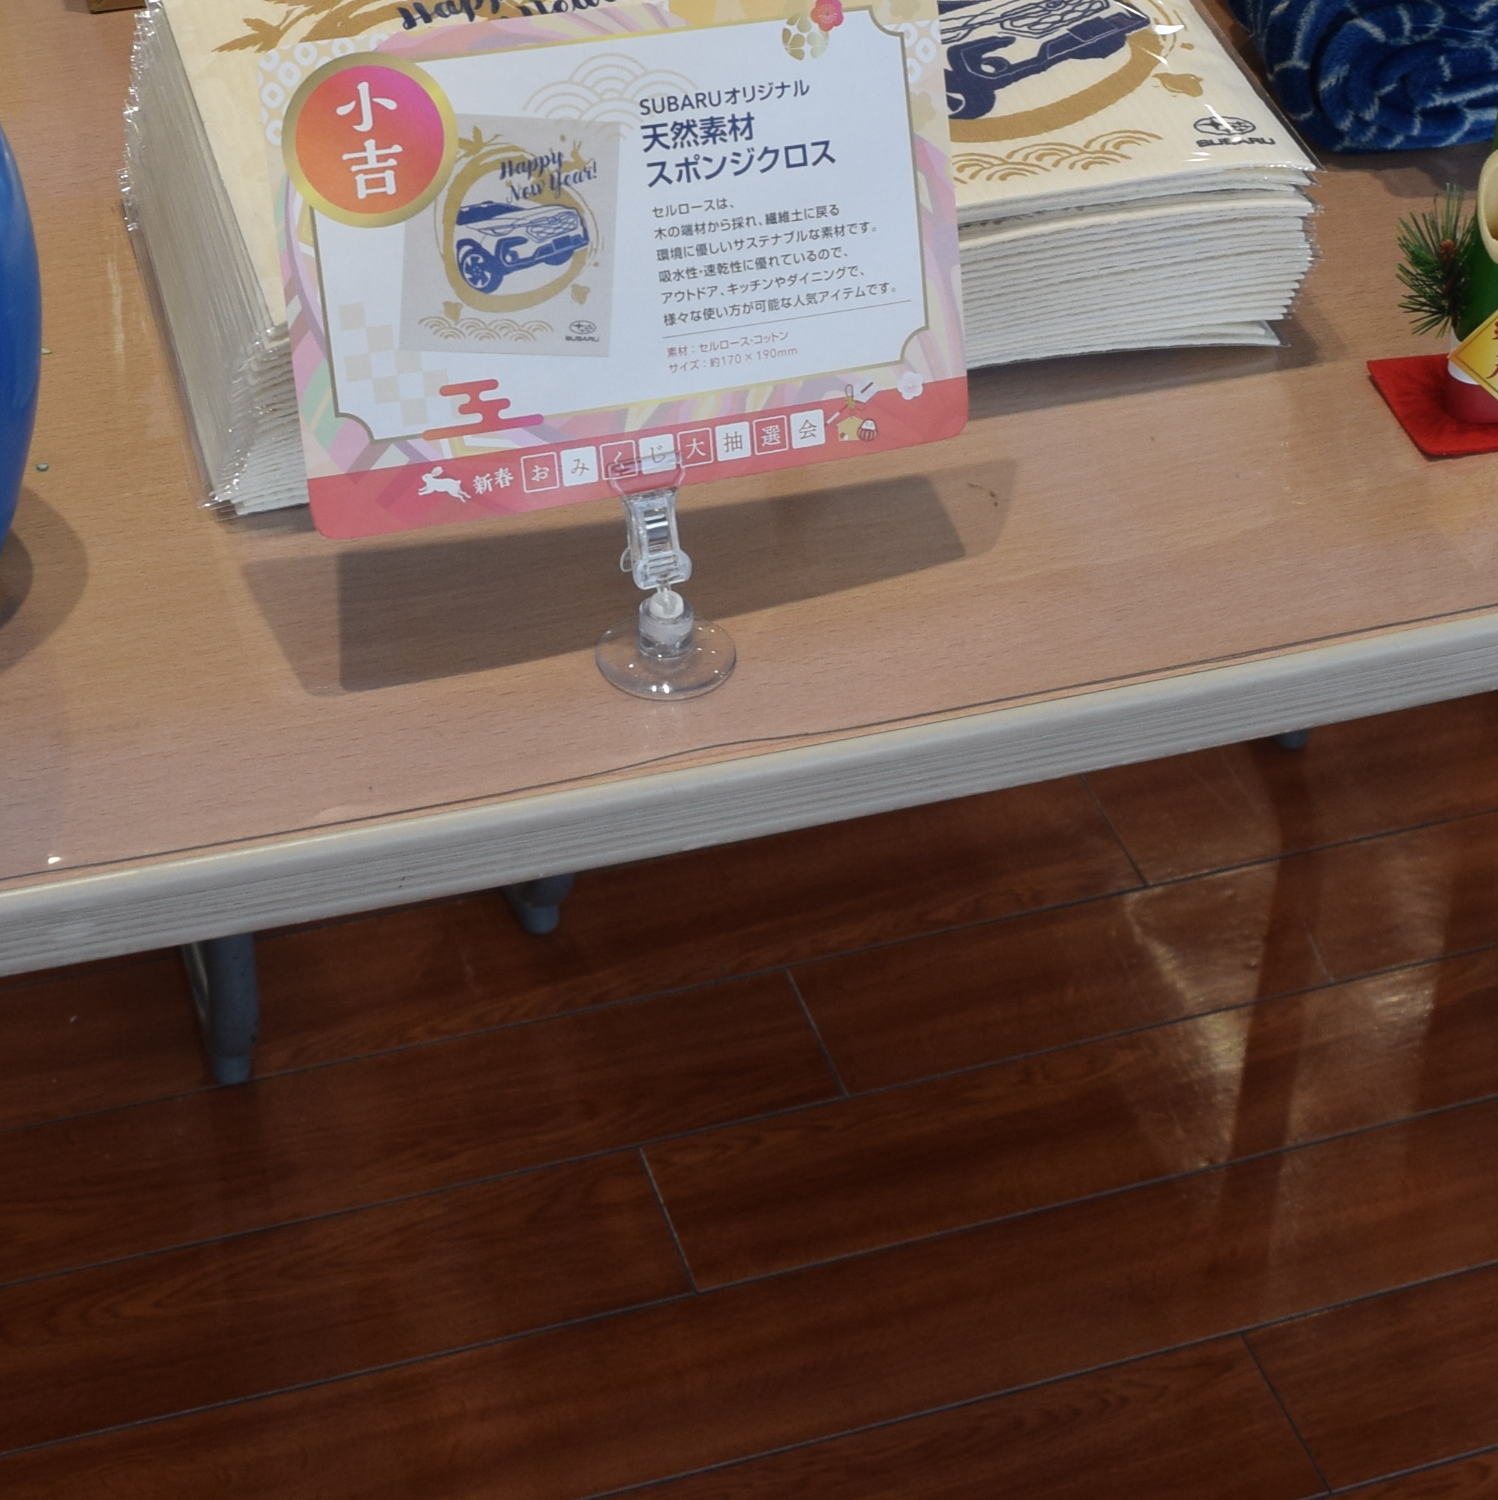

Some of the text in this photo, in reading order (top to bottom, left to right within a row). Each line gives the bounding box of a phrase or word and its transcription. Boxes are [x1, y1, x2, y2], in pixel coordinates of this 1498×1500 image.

[639, 79, 811, 117] SUBARUオリジナル
[335, 81, 403, 200] 小吉
[641, 113, 755, 153] 天然素材
[499, 149, 565, 181] Happy
[506, 161, 598, 204] New Year!
[645, 137, 836, 189] スポンジクロス
[651, 197, 735, 219] セルロースは、
[656, 221, 878, 262] 環境に優しいサステナブルな素材です。
[661, 265, 866, 305] アウトドア、キッチンやダイニングで、
[663, 282, 897, 327] 様々な使い方が可能な人気アイテムです。
[565, 335, 599, 343] SUBARU
